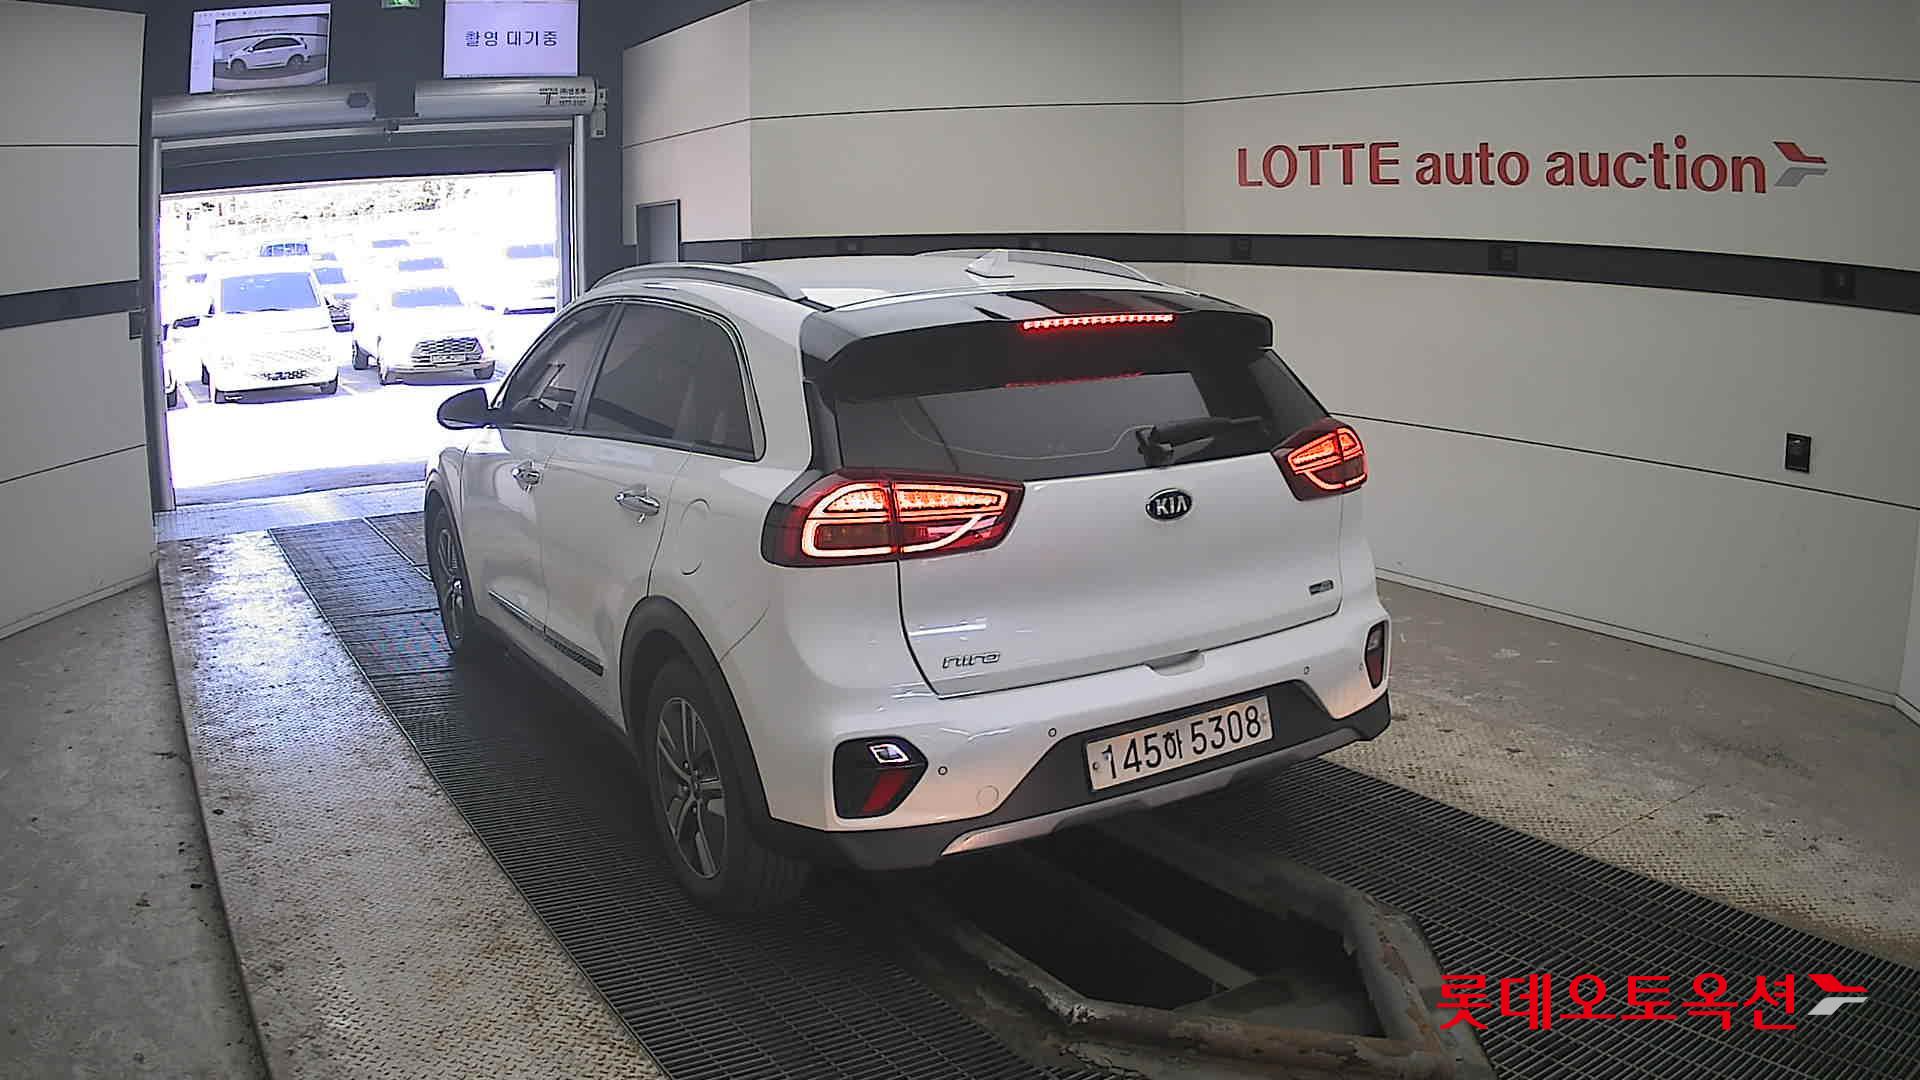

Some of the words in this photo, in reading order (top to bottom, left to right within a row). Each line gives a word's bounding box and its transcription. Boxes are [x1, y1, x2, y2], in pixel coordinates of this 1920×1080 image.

[1237, 142, 1400, 188] LOTTE
[1415, 142, 1531, 186] auto
[1545, 135, 1767, 193] auction
[1155, 495, 1188, 516] KIA
[1101, 729, 1183, 779] 145하
[1190, 705, 1262, 755] 5308
